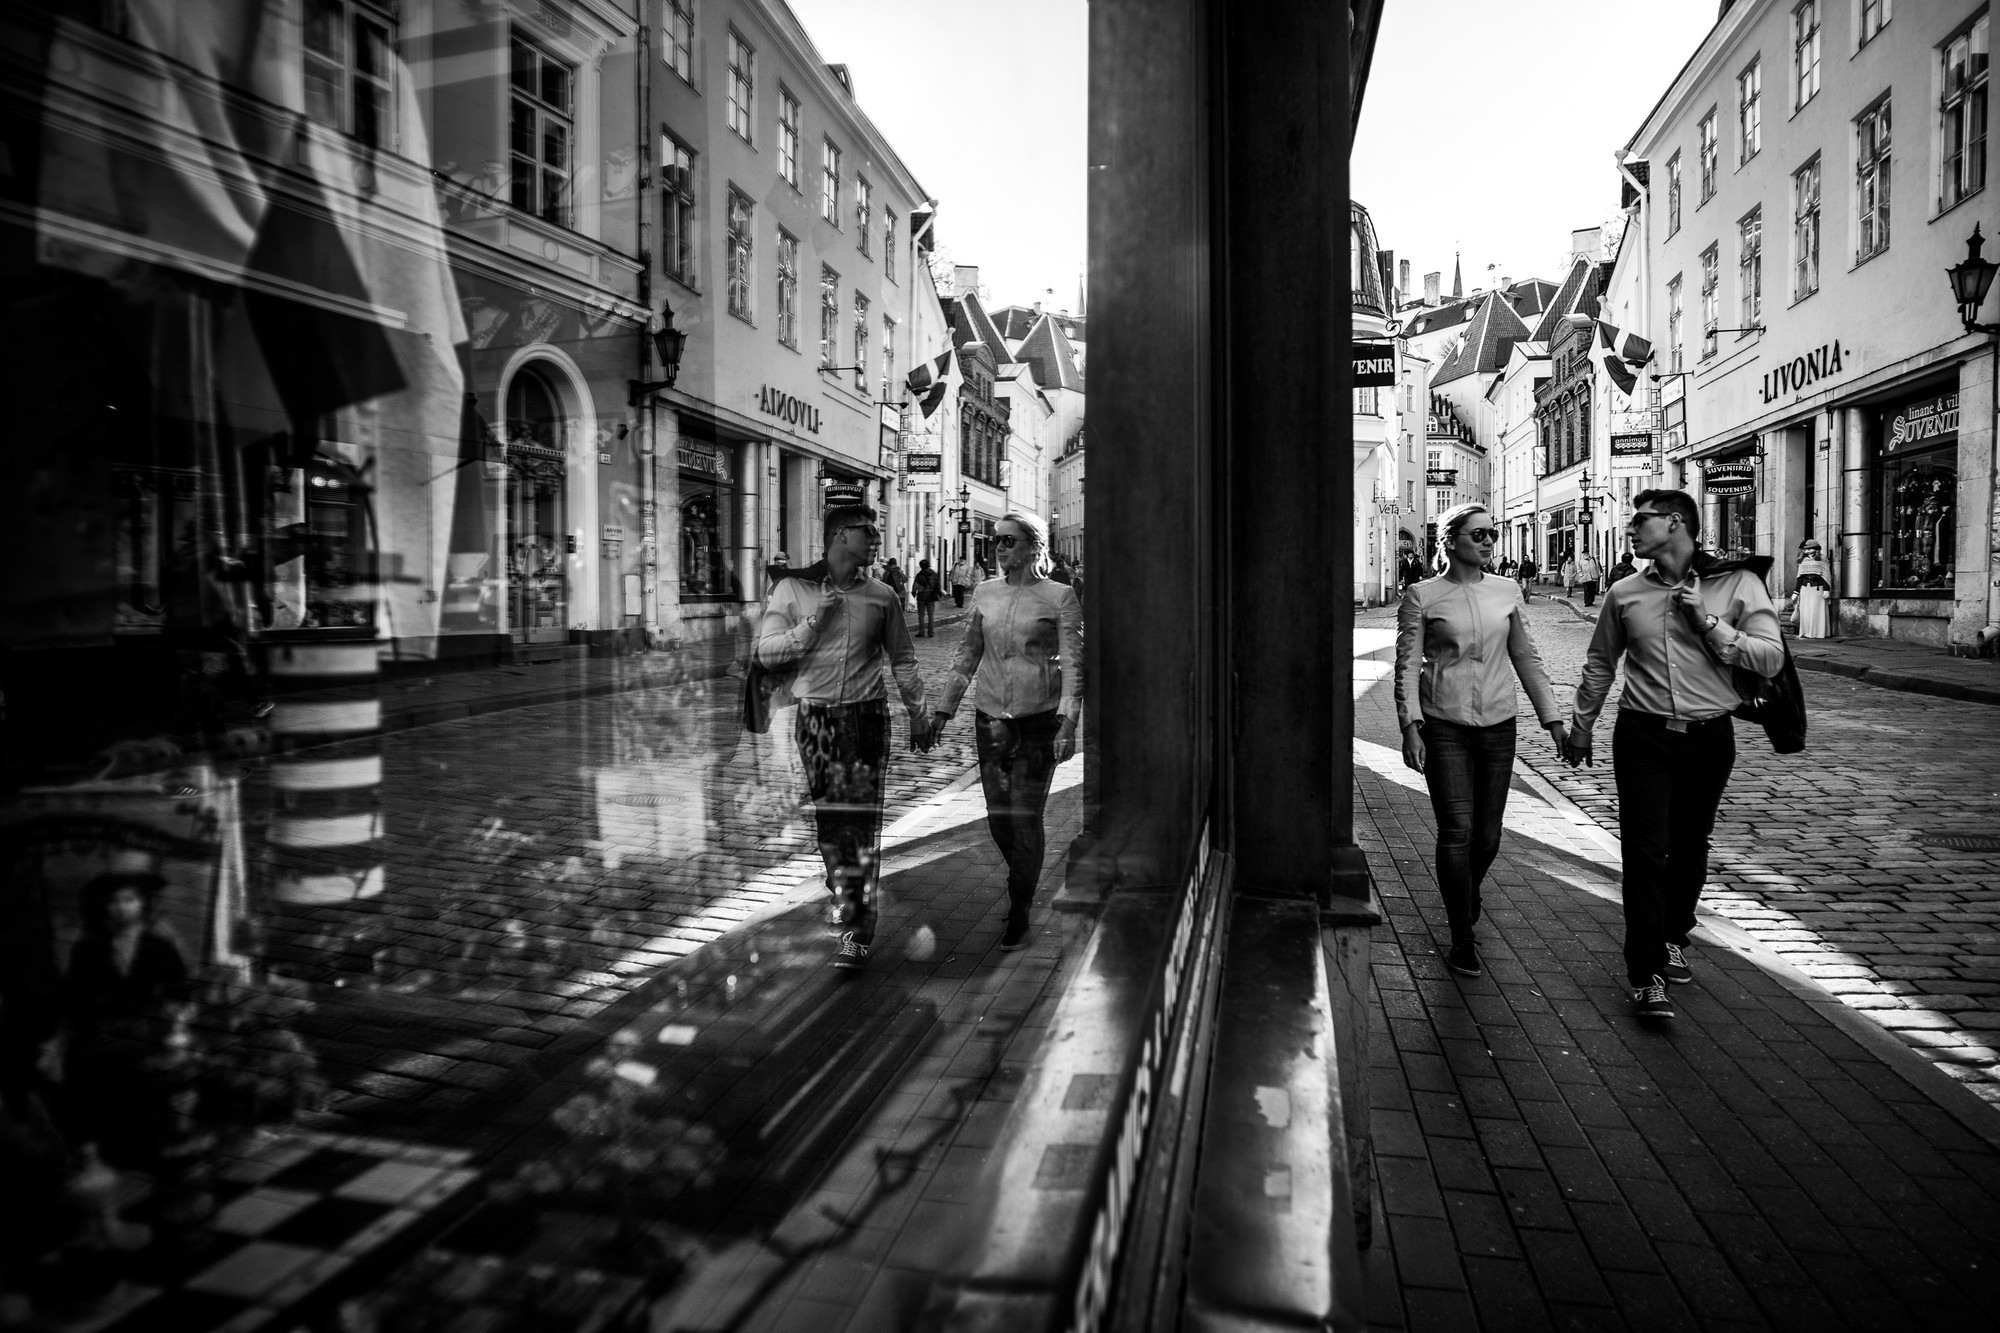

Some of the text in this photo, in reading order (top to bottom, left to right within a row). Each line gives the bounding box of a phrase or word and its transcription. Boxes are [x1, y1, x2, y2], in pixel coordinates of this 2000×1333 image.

[1763, 339, 1842, 404] LIVONIA
[1908, 404, 1934, 420] linane
[1936, 398, 1944, 412] &
[1706, 465, 1752, 475] SUVENIIRID
[1707, 484, 1752, 493] SOUVENIRS
